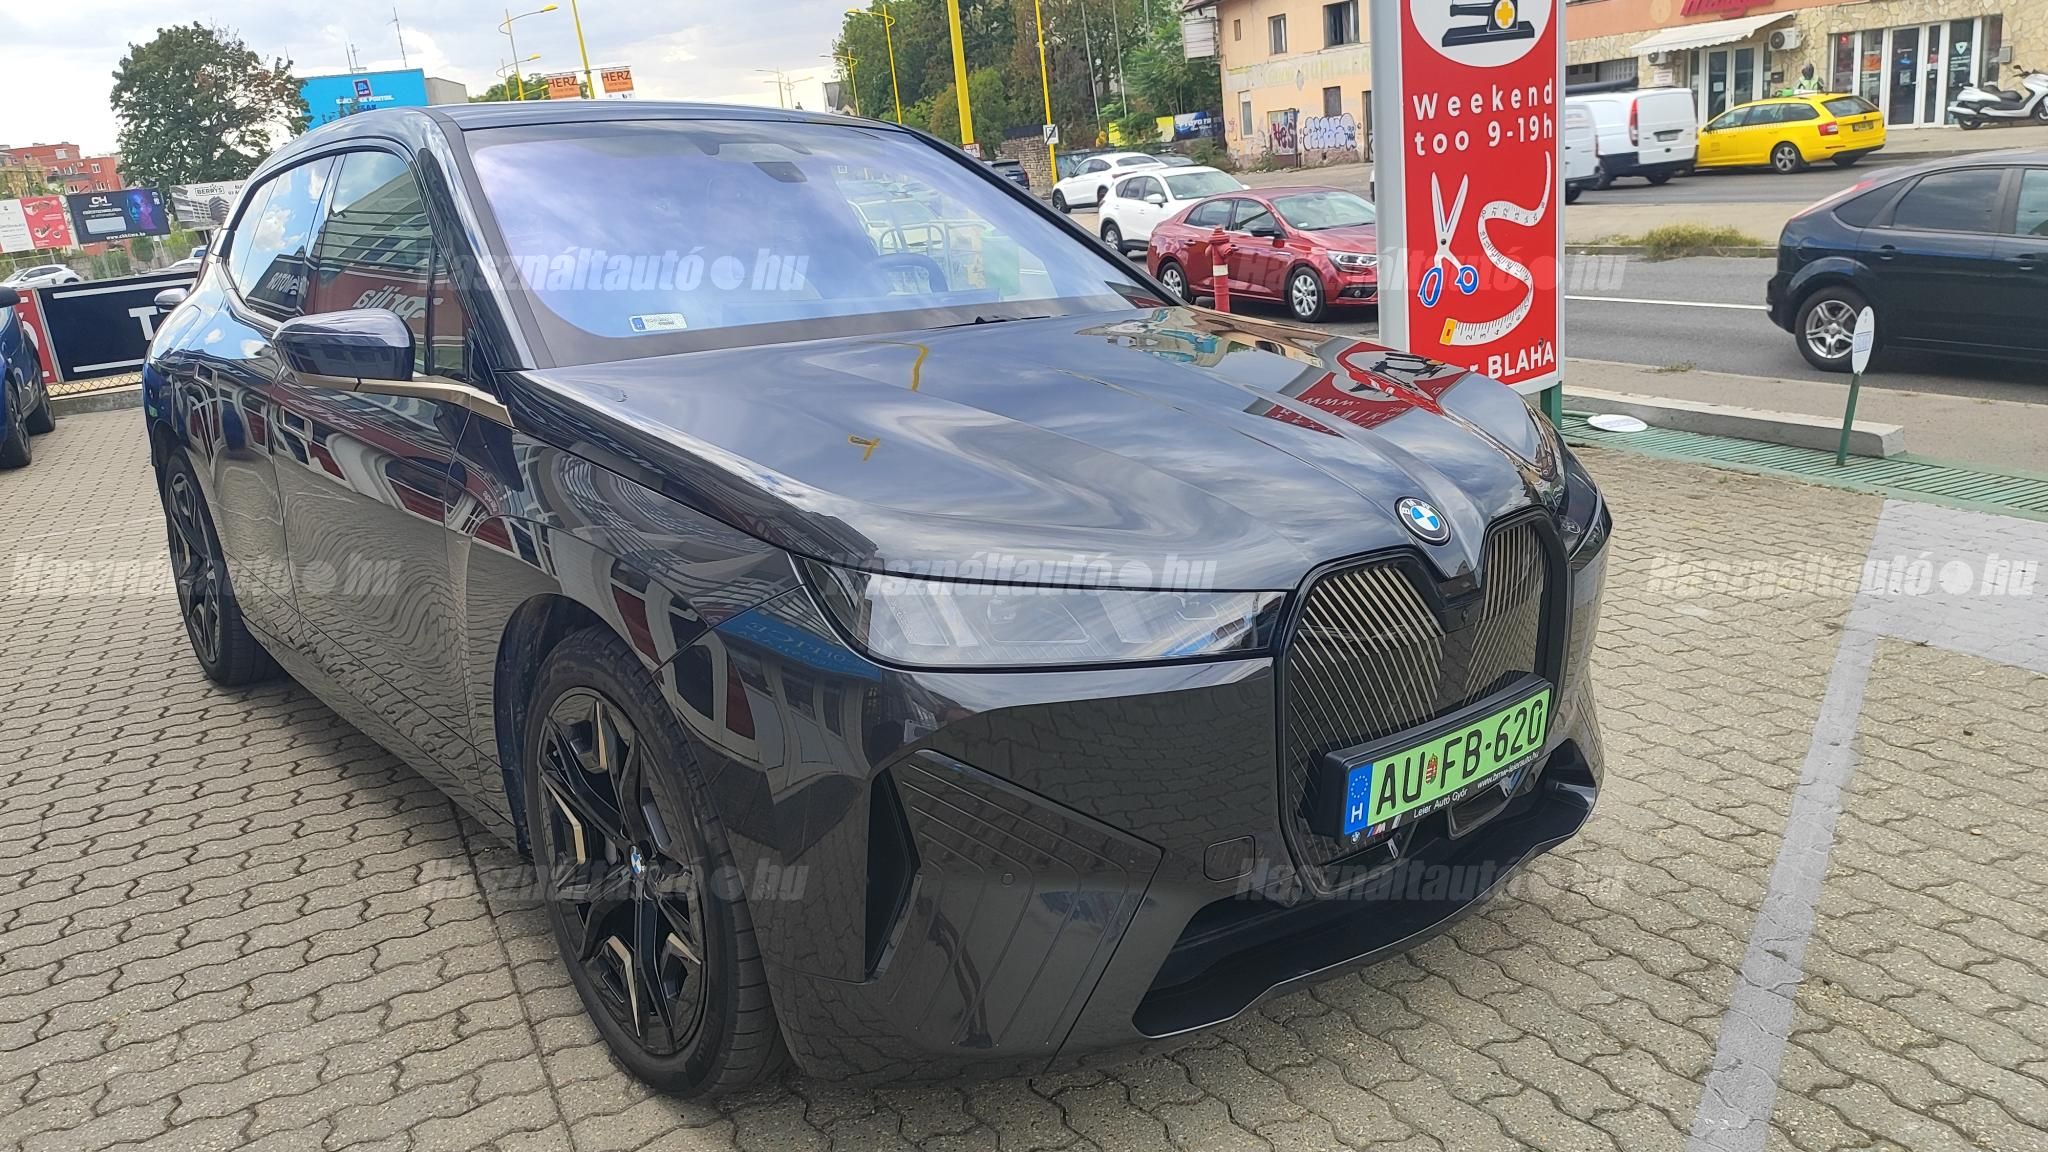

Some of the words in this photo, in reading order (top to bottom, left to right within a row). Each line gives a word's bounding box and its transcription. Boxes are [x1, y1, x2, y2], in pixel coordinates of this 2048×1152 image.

[601, 70, 632, 82] HERZ
[1412, 77, 1553, 121] Weekend
[1414, 130, 1470, 156] too
[1487, 112, 1553, 147] 9-19h
[1487, 341, 1555, 380] BLAHA
[1350, 802, 1364, 824] H
[1413, 804, 1432, 819] Leier
